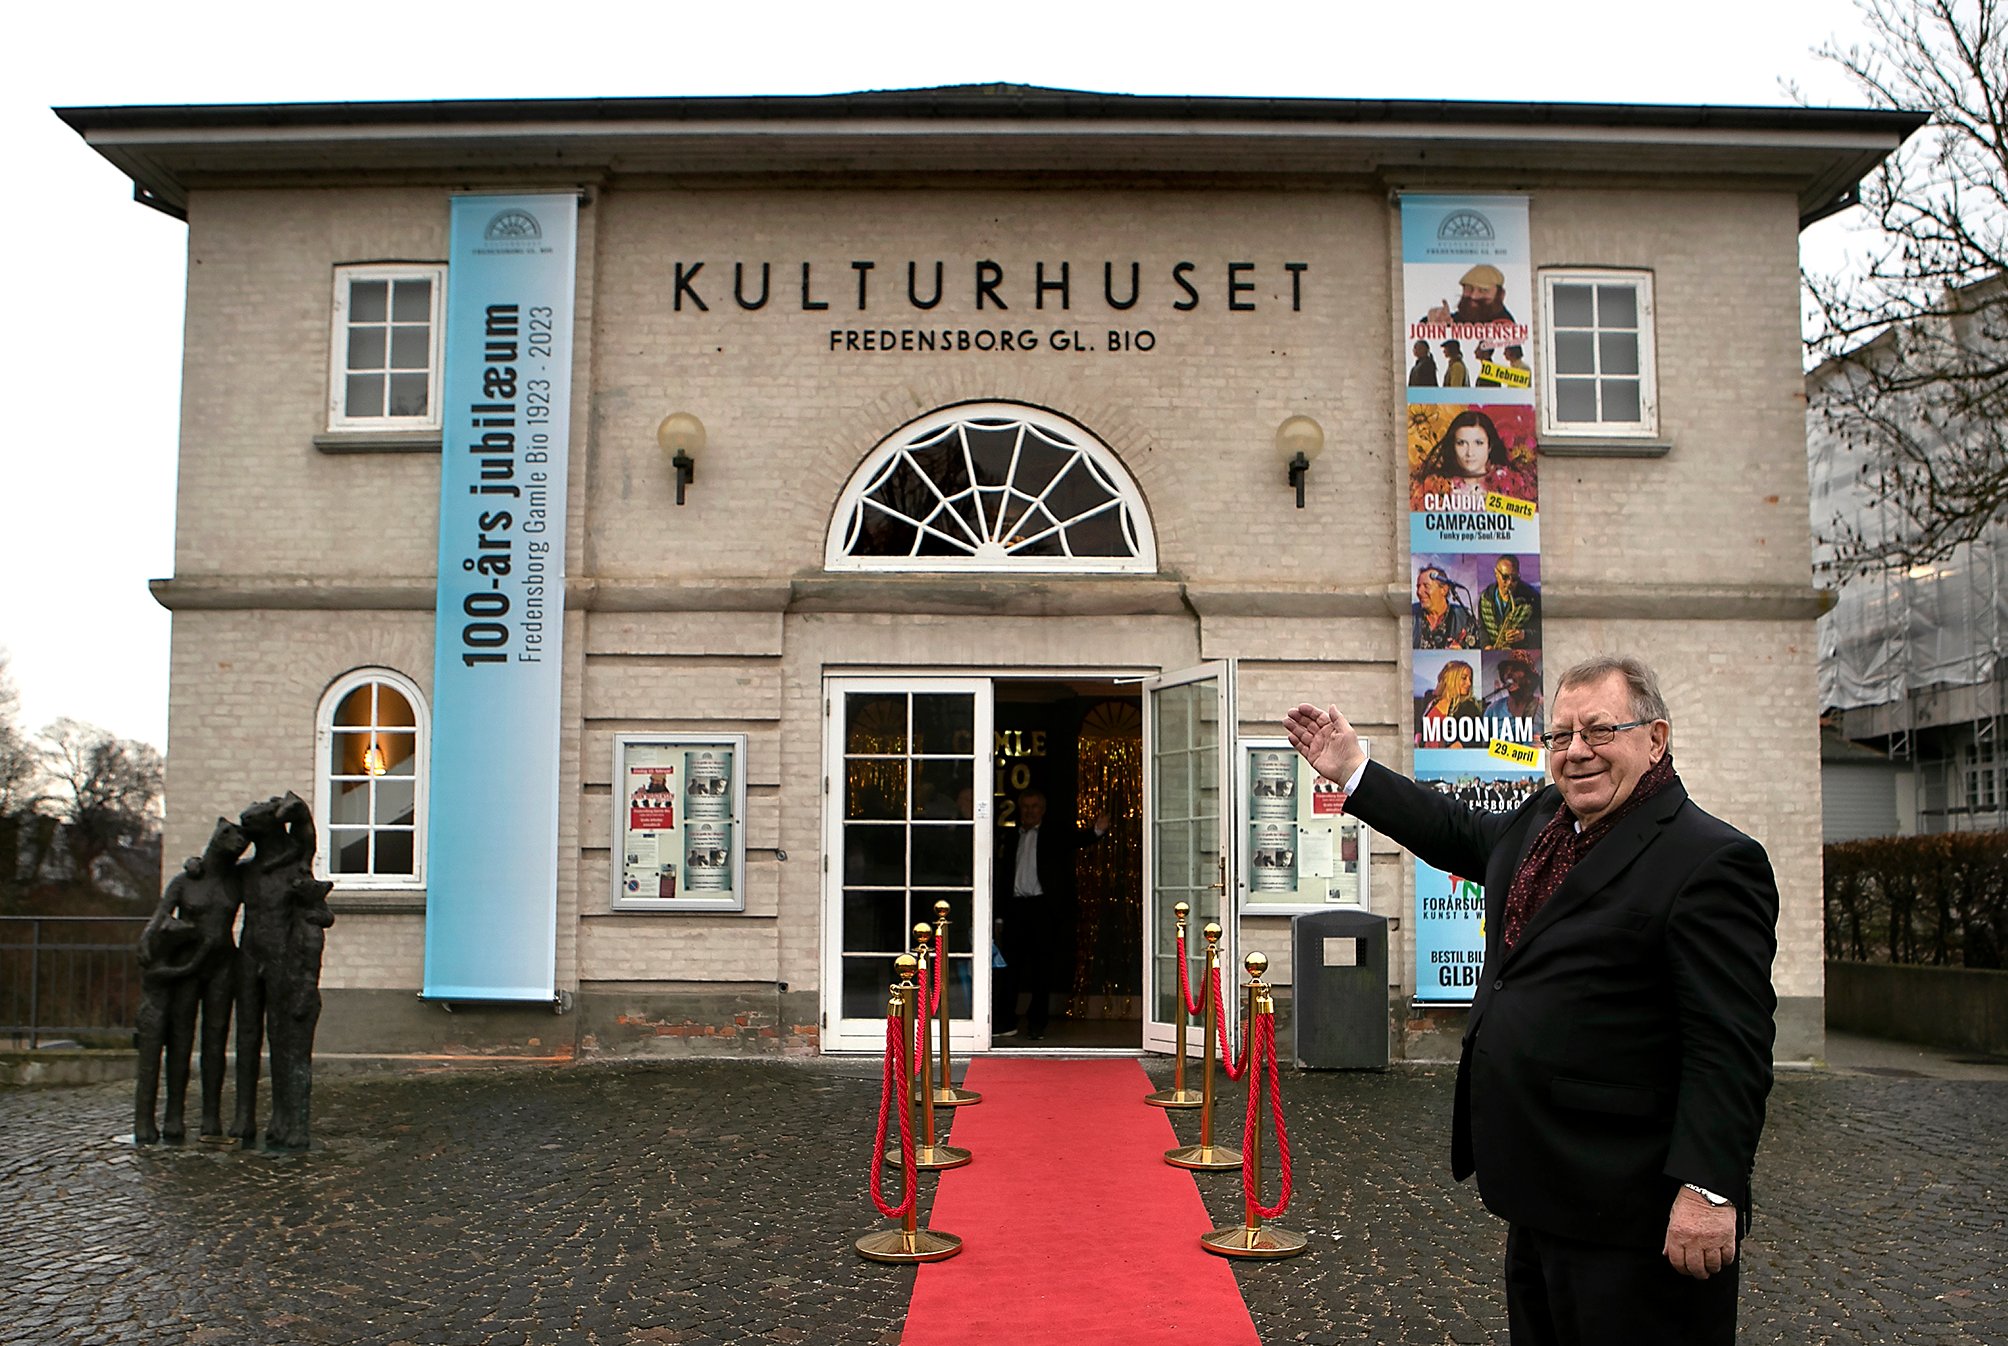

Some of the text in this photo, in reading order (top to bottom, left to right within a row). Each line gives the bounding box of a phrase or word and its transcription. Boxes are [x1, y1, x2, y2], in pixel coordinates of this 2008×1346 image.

[674, 259, 1308, 312] KULTURHUSET
[529, 306, 553, 358] 2023
[830, 330, 1156, 352] FREDENSBORG GL. BIO
[1409, 322, 1529, 340] JOHN MOGENSEN
[1481, 363, 1529, 385] 10. februar
[470, 303, 520, 498] jubilæum
[527, 379, 551, 427] 1923
[525, 434, 549, 464] Bio
[523, 472, 548, 534] Gamle
[1424, 492, 1486, 511] CLAUDIA
[1488, 496, 1533, 517] 25. marts
[1425, 513, 1515, 531] CAMPAGNOL
[1439, 531, 1460, 541] Funky
[462, 509, 512, 667] 100-års
[519, 541, 550, 663] Fredensborg
[1423, 716, 1533, 743] MOONJAM
[1494, 742, 1534, 763] 29. april
[1423, 894, 1486, 911] FORÅRSUD
[1423, 911, 1457, 920] KUNST
[1463, 911, 1469, 920] &
[1431, 950, 1484, 963] BESTIL BIL
[1439, 965, 1480, 987] GLBI
